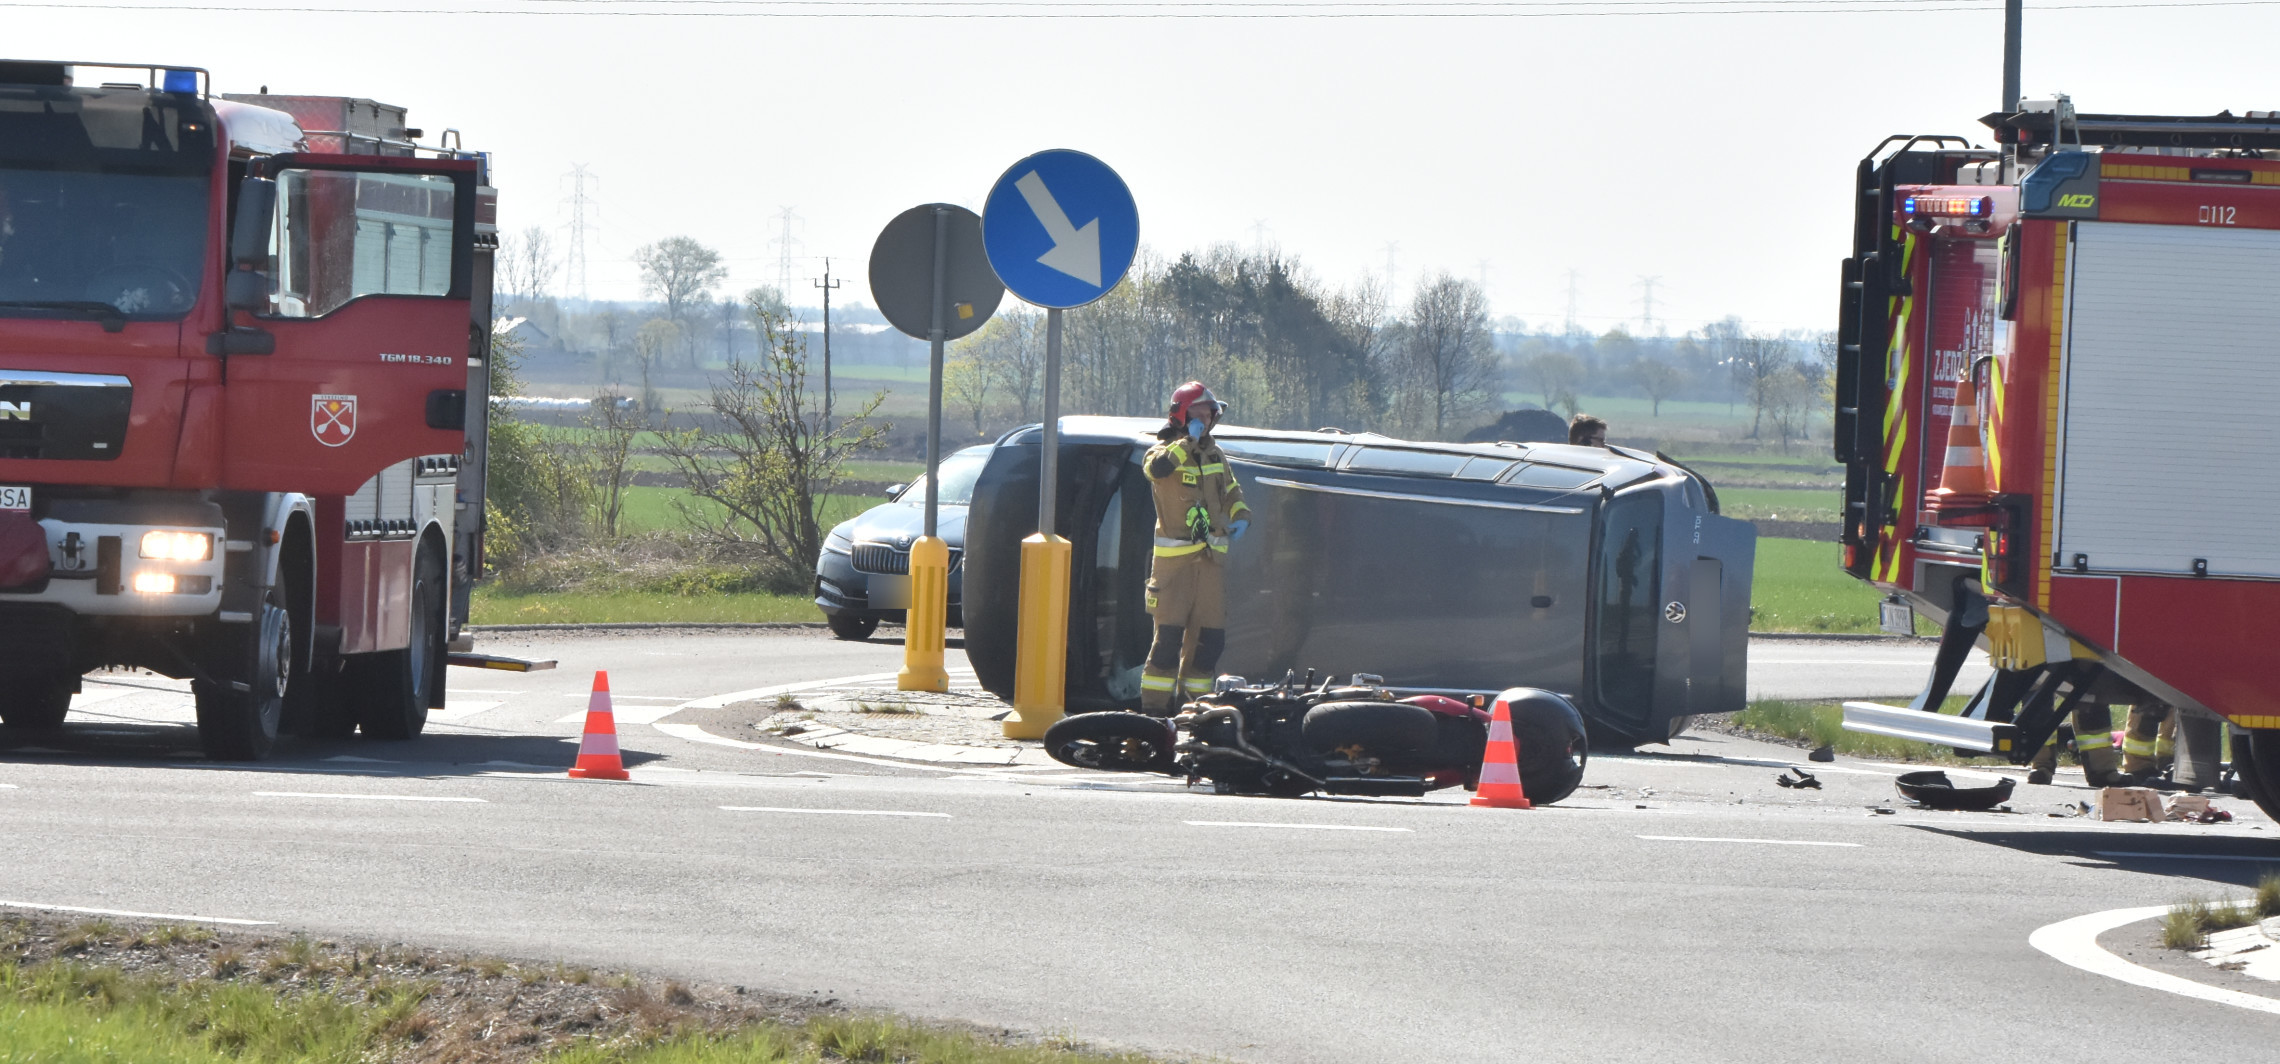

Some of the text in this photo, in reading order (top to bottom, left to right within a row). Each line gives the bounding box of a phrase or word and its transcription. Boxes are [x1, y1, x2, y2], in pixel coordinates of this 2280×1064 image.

[2211, 206, 2236, 224] 112
[379, 353, 452, 365] TGM 18.340
[0, 488, 27, 508] SA
[1694, 515, 1702, 530] TDI
